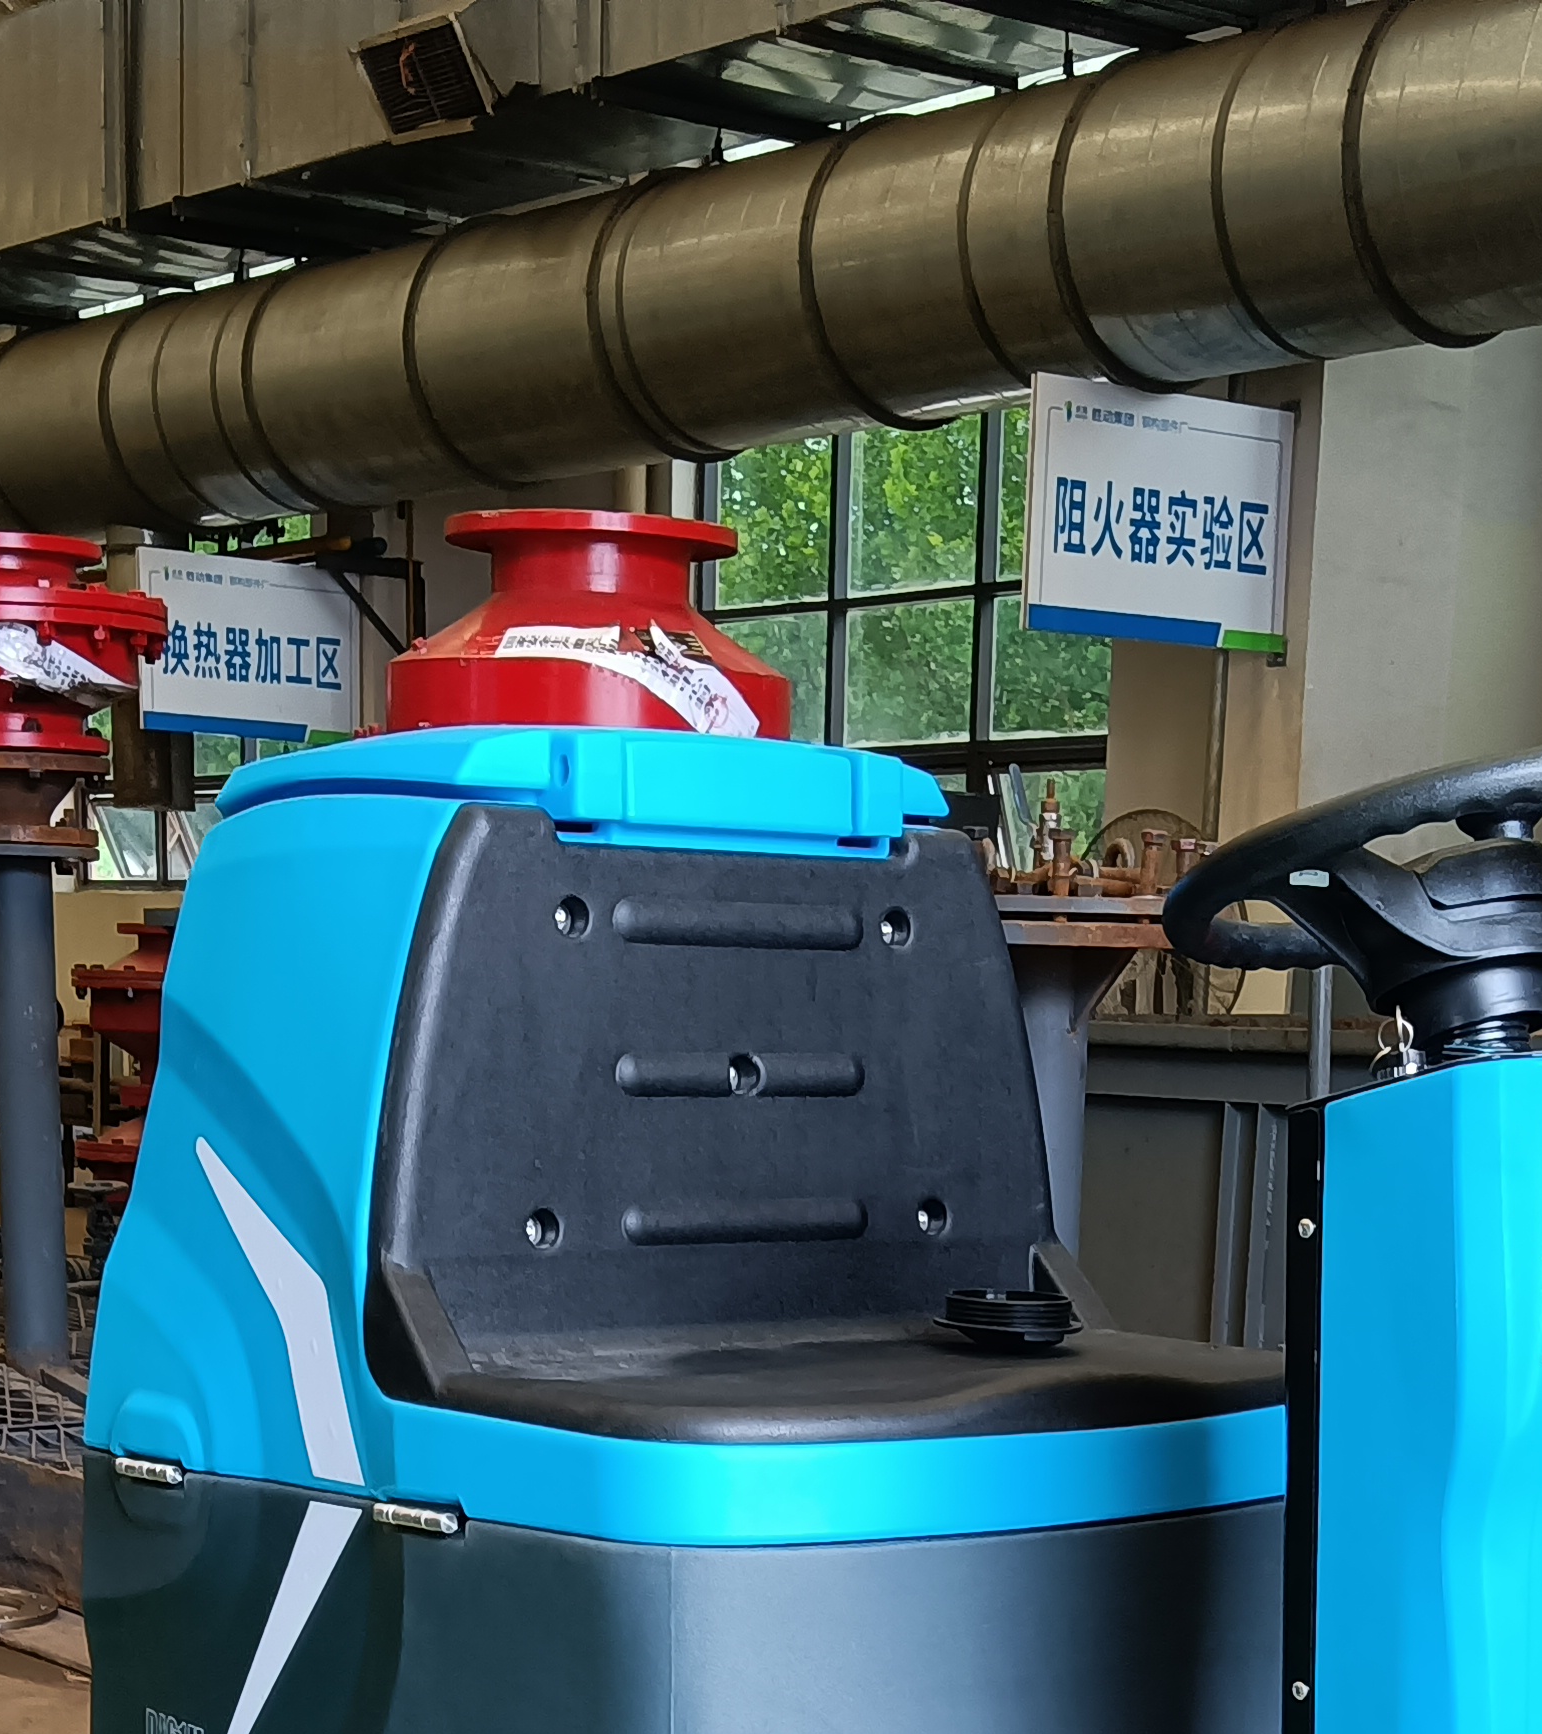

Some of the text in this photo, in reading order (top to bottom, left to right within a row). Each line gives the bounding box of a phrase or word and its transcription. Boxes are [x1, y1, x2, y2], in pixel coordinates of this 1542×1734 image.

[1053, 476, 1269, 576] 阻火器实验区
[162, 620, 342, 690] 换热器加工区
